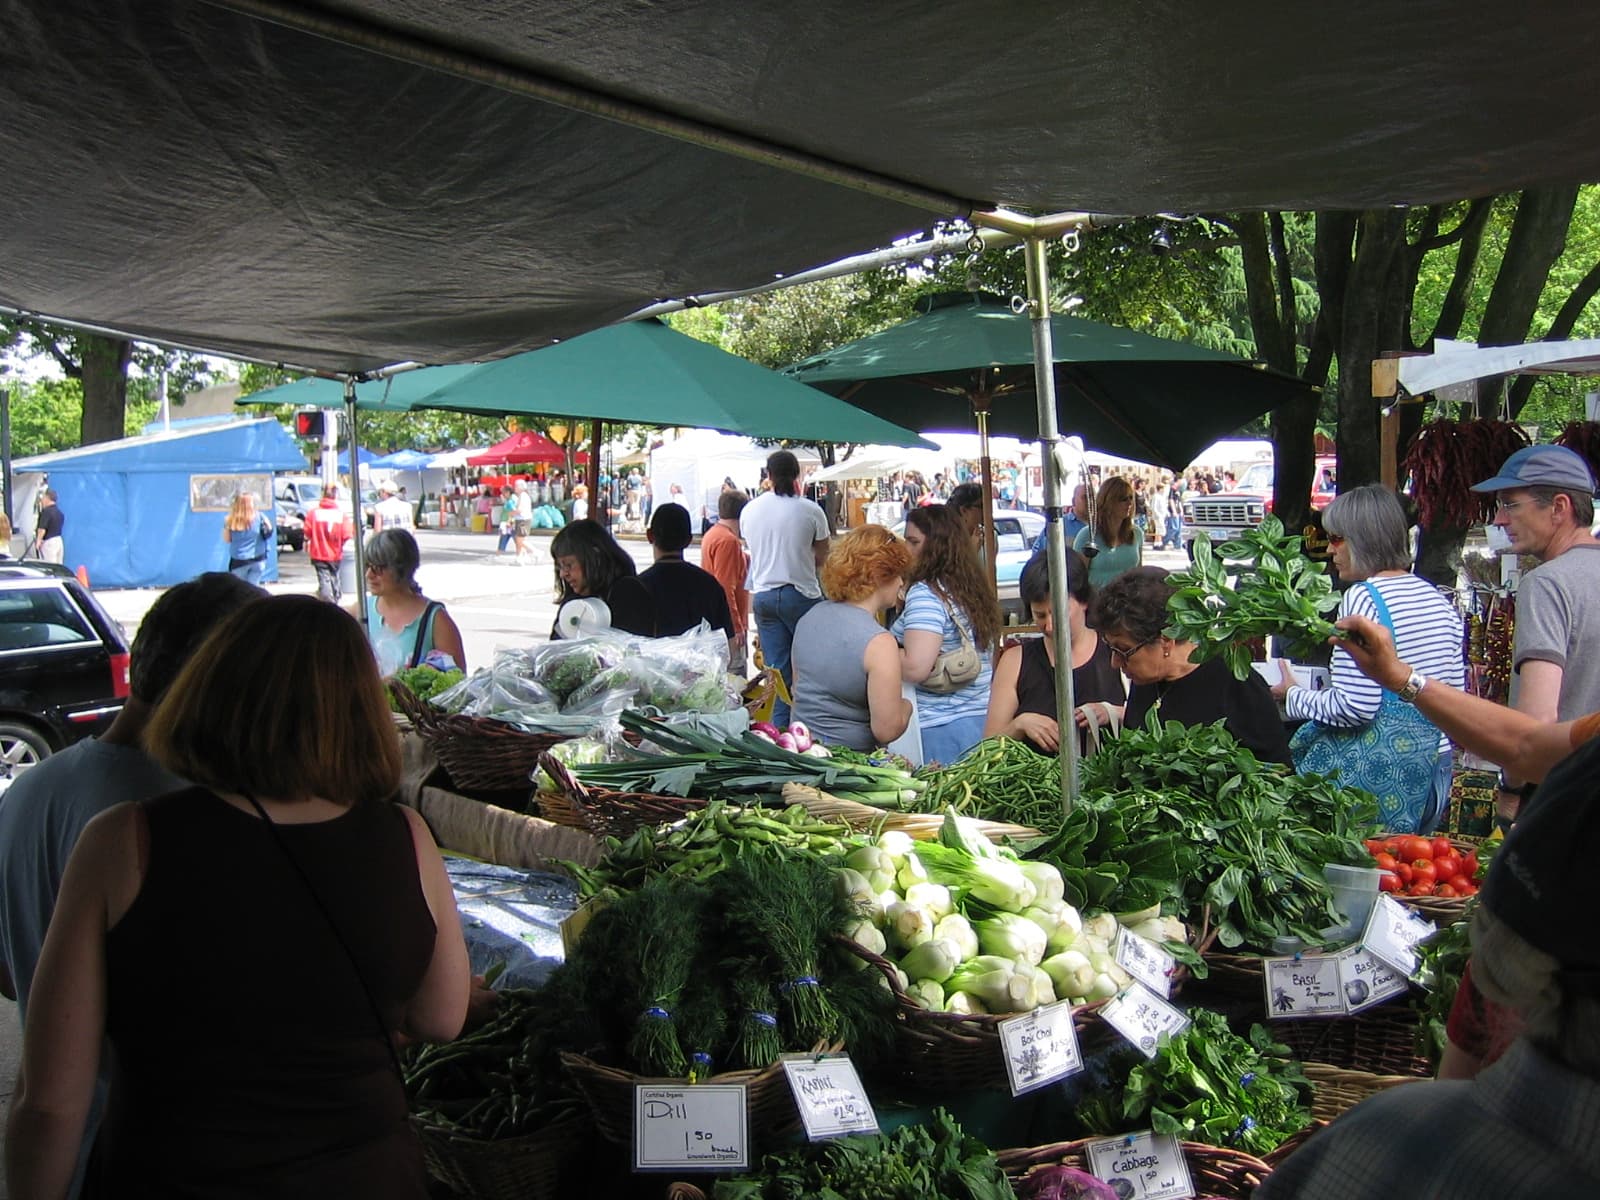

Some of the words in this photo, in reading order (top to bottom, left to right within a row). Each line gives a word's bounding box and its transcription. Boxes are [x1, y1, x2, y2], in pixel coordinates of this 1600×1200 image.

[1292, 973, 1321, 986] BASIL
[644, 1100, 687, 1120] Dill
[1112, 1154, 1159, 1174] Cabbage
